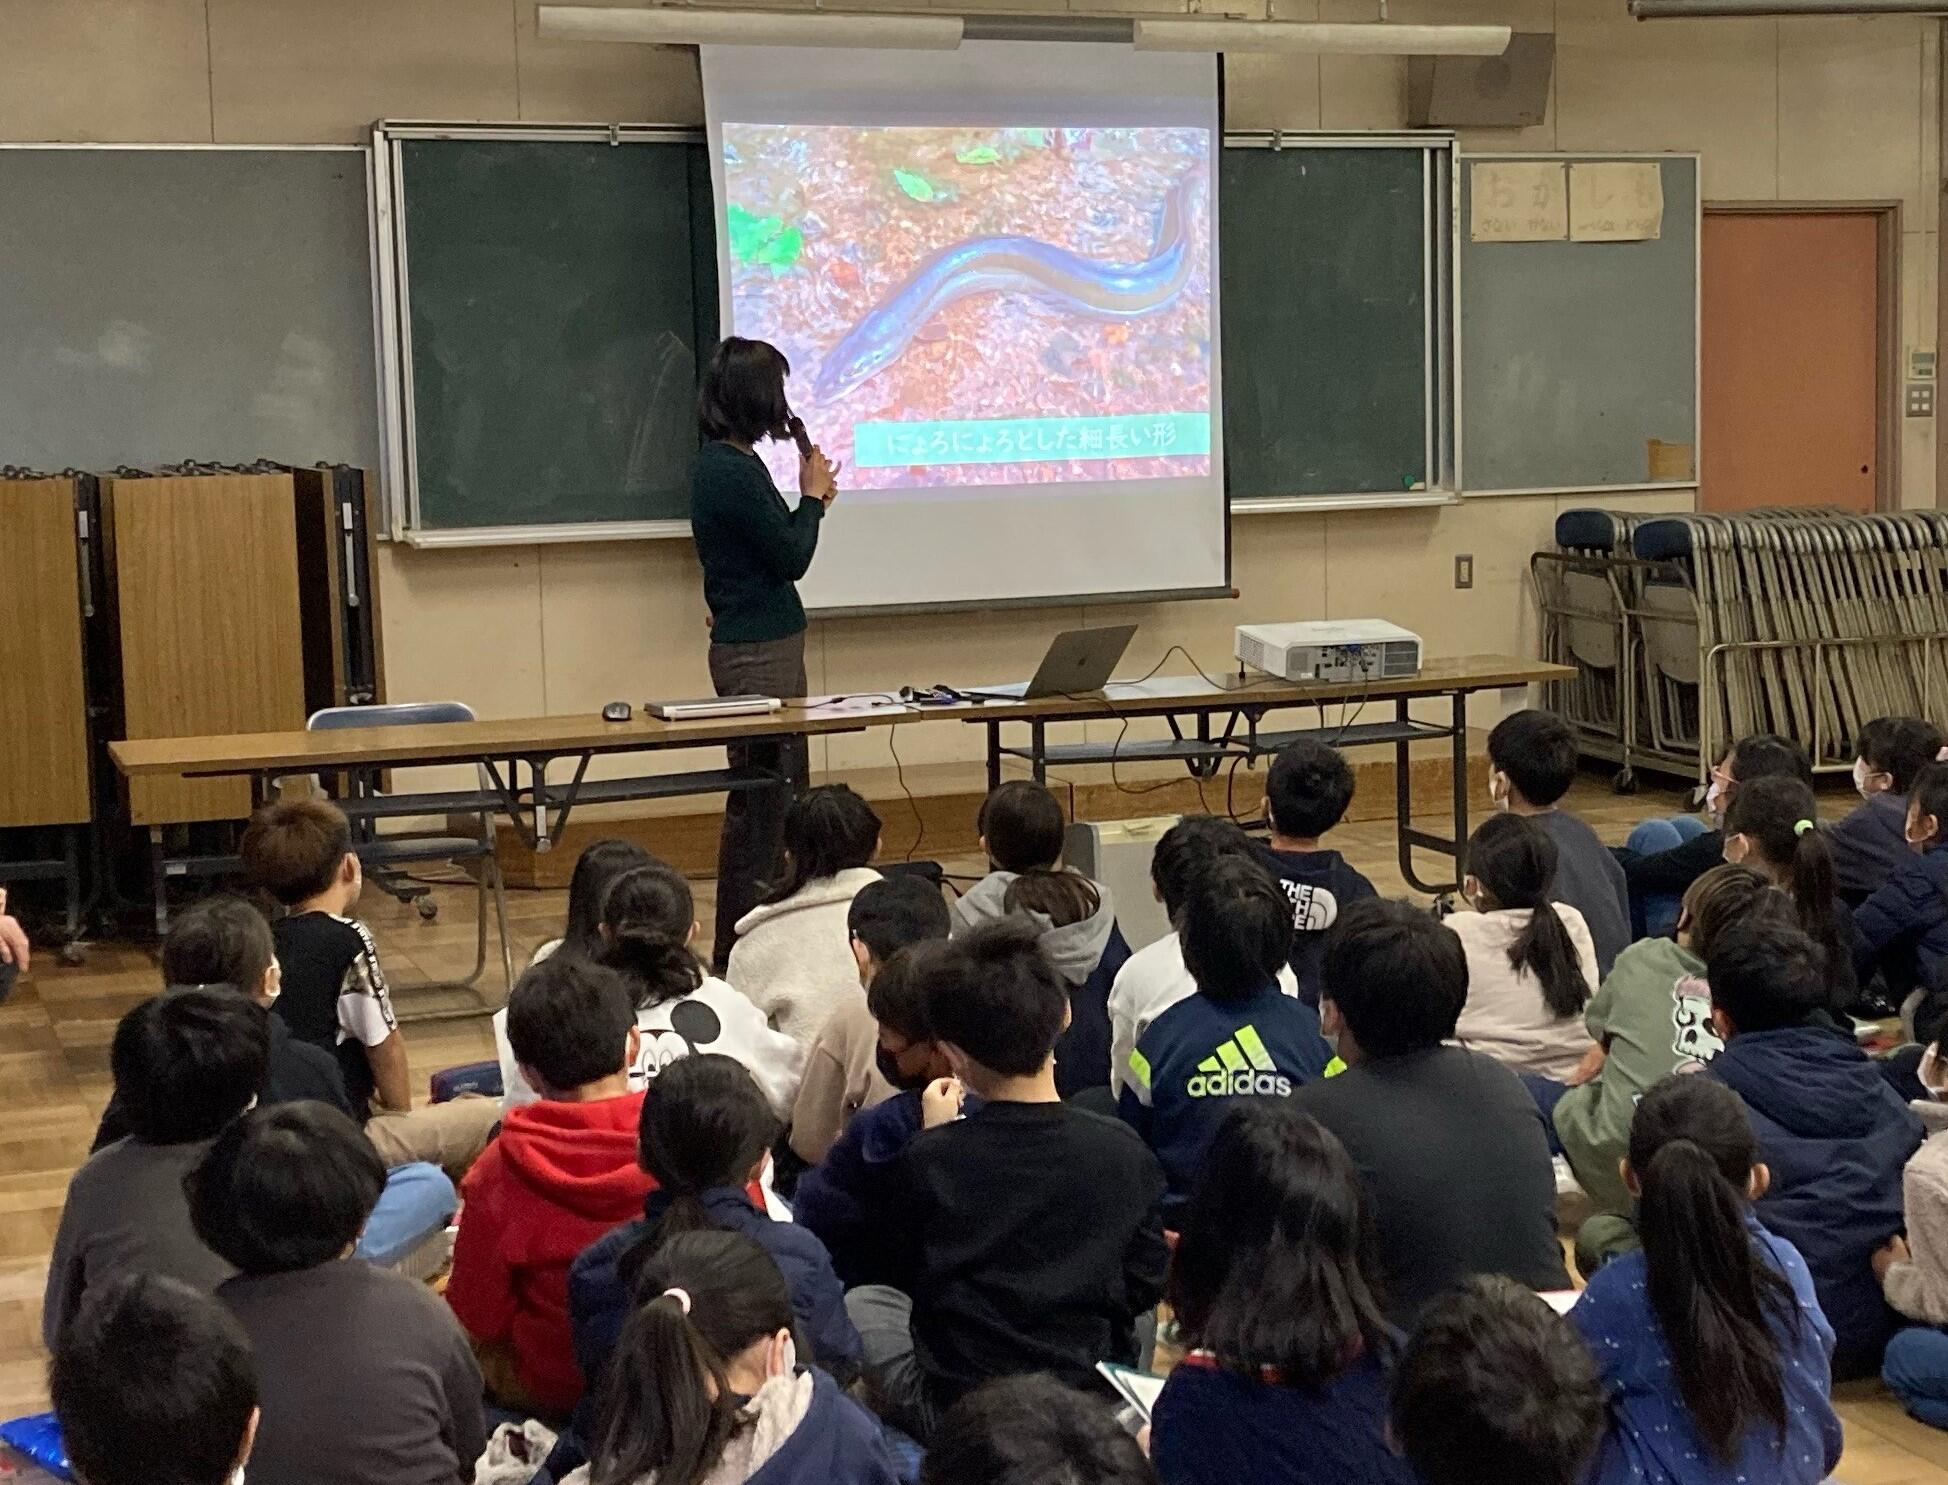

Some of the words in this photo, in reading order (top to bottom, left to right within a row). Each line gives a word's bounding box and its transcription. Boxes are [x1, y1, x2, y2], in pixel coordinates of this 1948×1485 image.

[888, 421, 1177, 456] にょろにょろとした細長い形
[1279, 878, 1313, 899] THE
[1187, 1069, 1292, 1097] adidas
